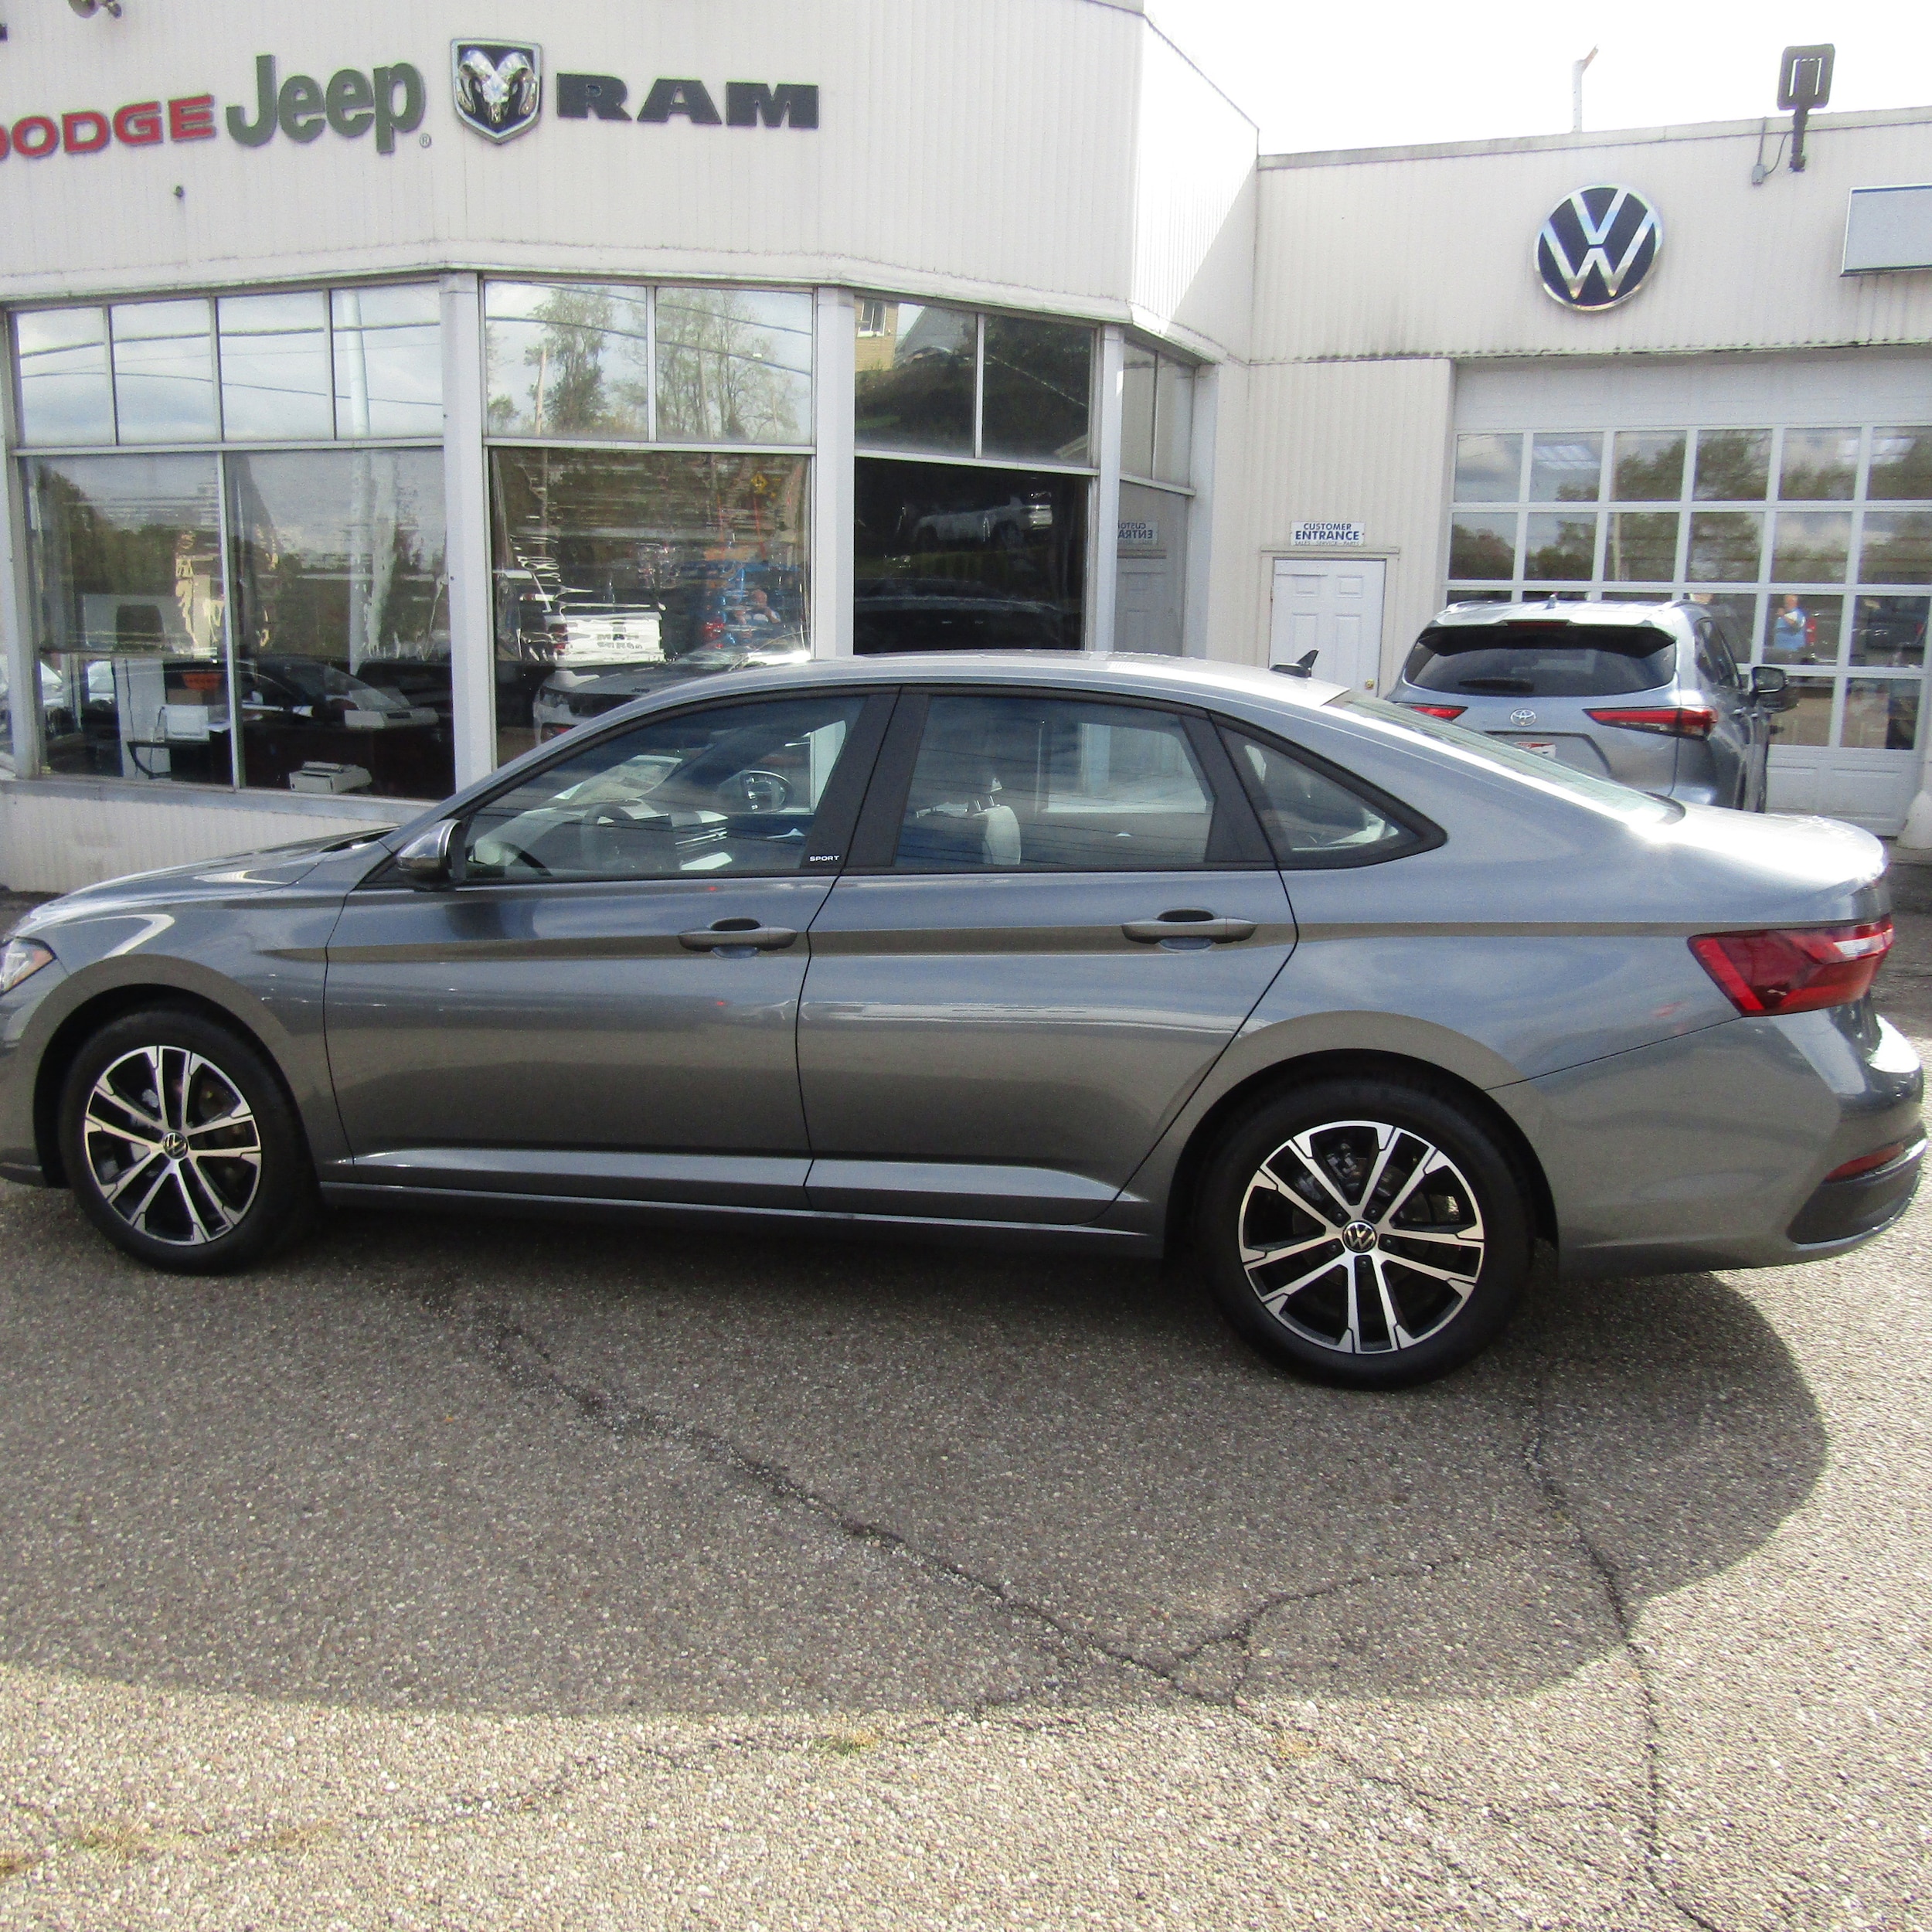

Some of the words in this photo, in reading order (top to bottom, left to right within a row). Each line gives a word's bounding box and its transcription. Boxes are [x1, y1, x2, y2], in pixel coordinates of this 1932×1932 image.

[0, 94, 216, 163] ODGE
[226, 55, 426, 155] Jeep
[556, 73, 819, 129] RAM
[1295, 531, 1359, 540] ENTRANCE
